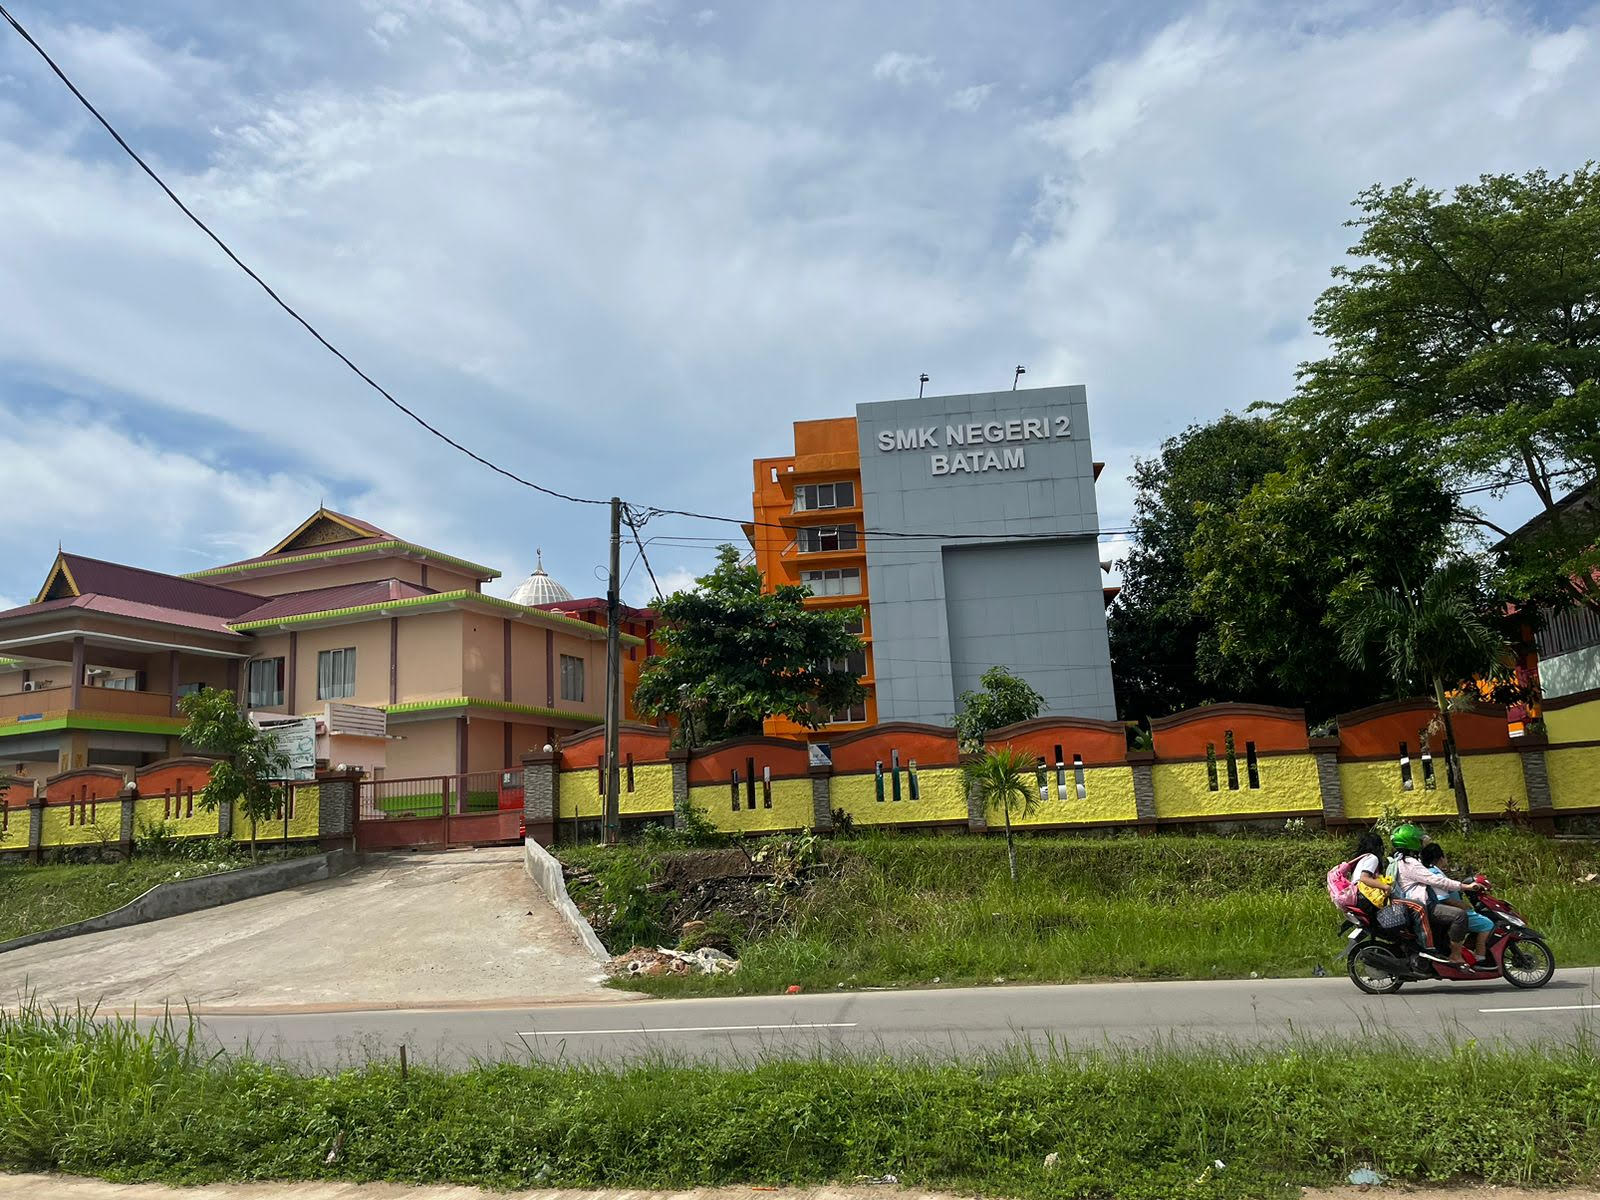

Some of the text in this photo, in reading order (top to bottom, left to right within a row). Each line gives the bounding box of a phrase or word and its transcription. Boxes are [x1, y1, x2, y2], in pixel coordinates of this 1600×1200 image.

[878, 416, 1071, 452] SMK NEGERI 2
[930, 447, 1025, 476] BATAM
